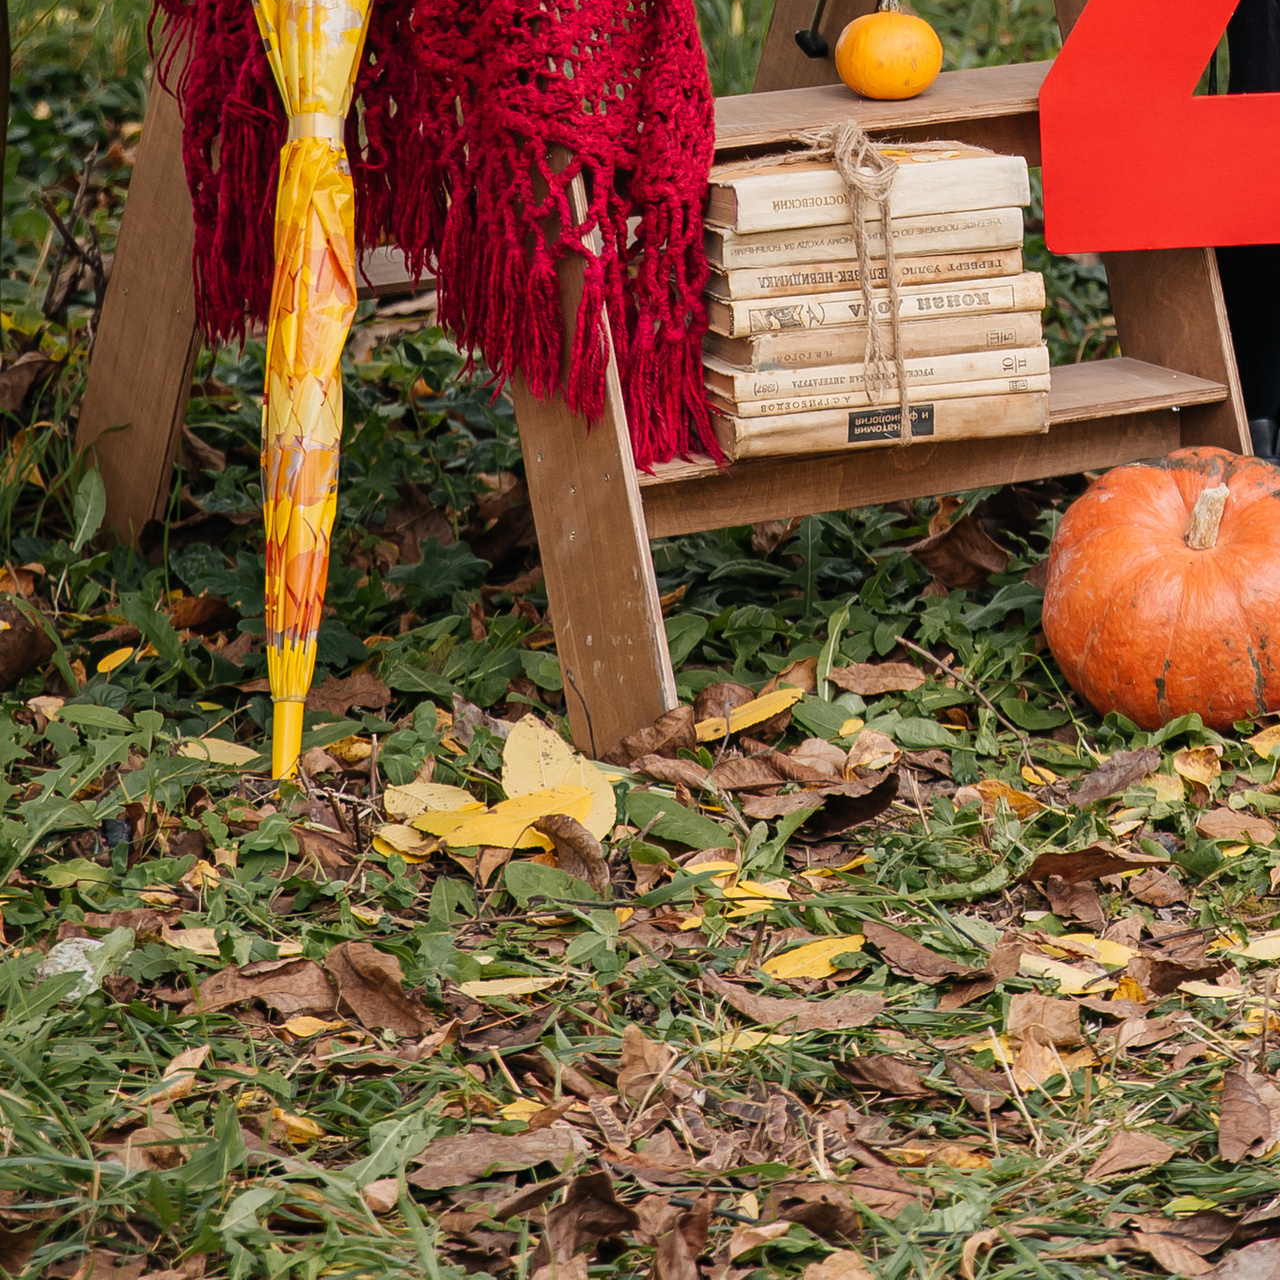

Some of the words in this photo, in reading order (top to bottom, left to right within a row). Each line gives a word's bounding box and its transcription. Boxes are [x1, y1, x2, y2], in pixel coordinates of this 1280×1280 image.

[916, 223, 959, 234] ПОСОБИЕ
[901, 264, 941, 275] УЭЛЛС
[947, 259, 1002, 271] ГЕРБЕРТ
[1002, 357, 1014, 371] 10
[791, 375, 846, 388] ЛИТЕРАТУРА
[921, 411, 929, 419] и
[854, 423, 901, 435] натомия
